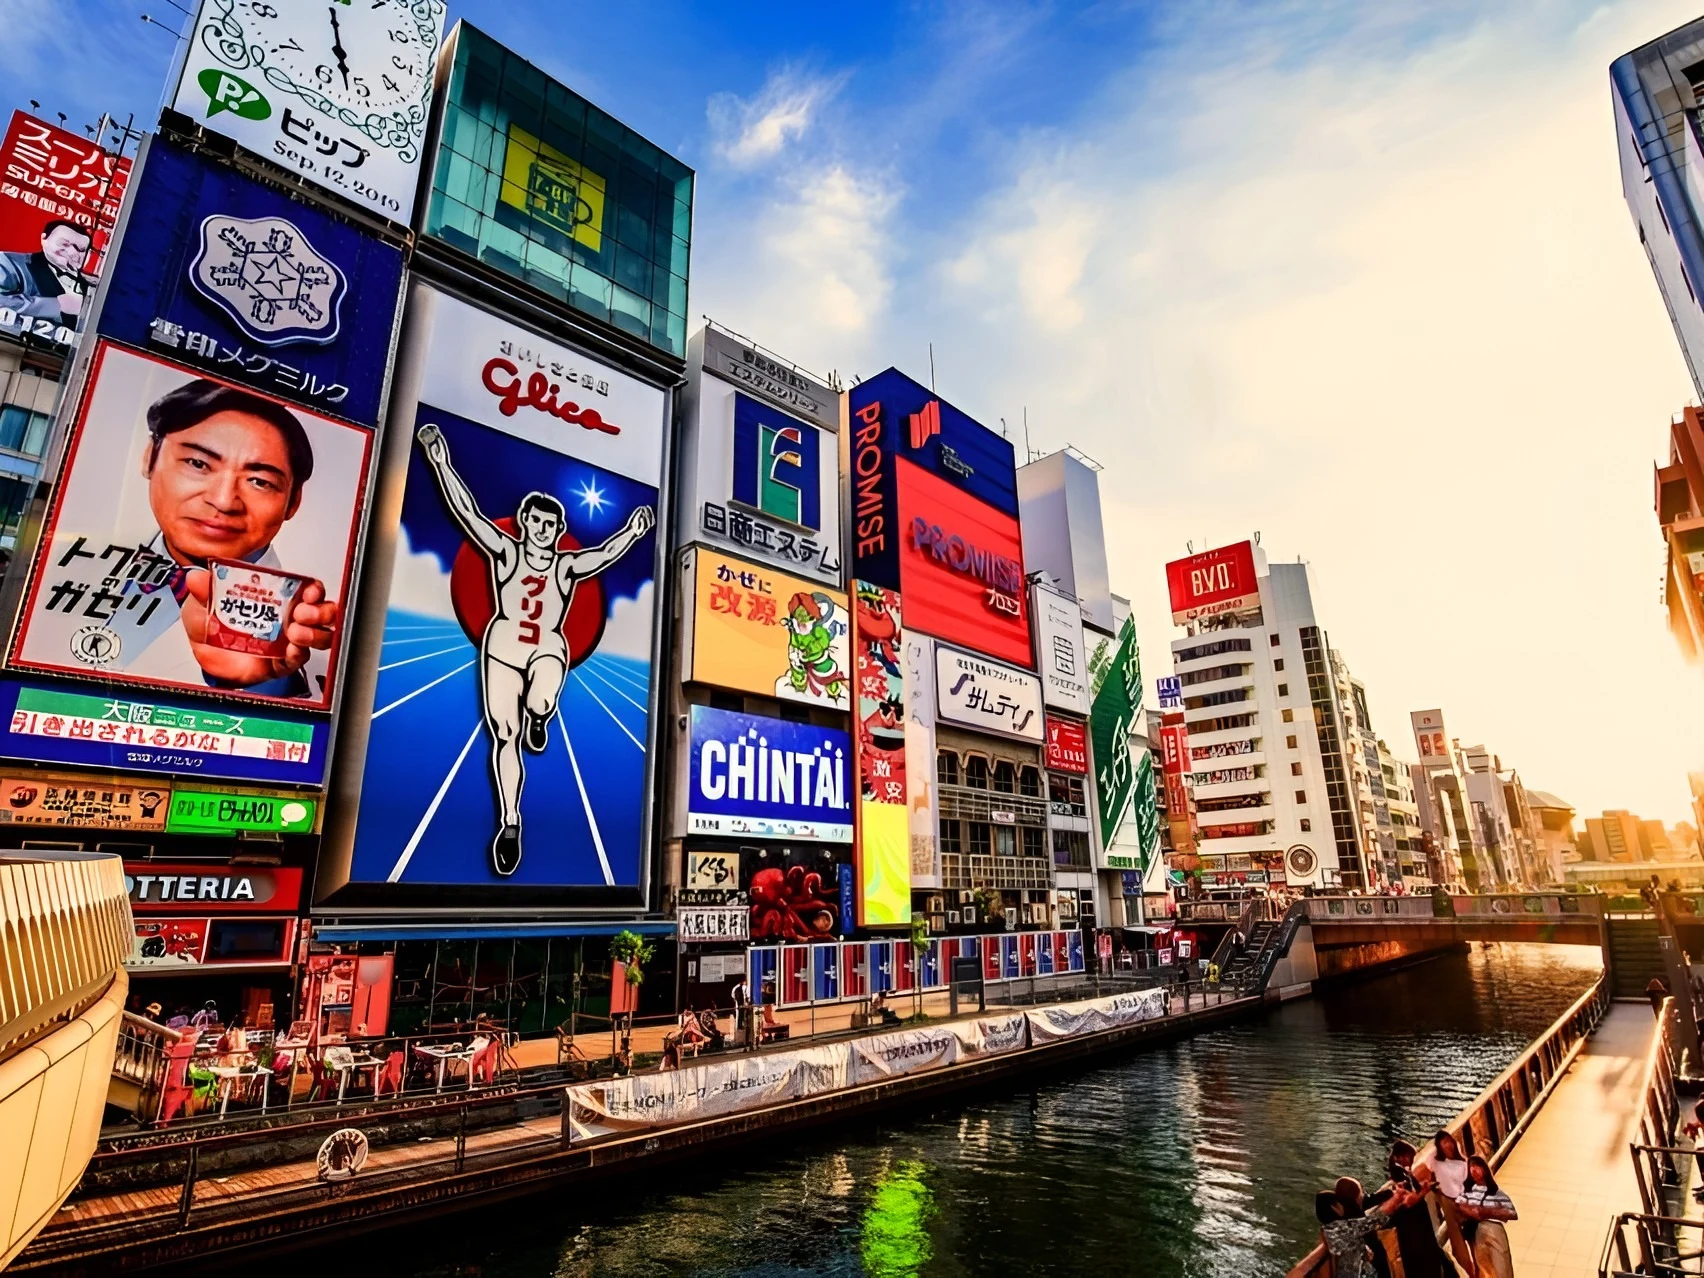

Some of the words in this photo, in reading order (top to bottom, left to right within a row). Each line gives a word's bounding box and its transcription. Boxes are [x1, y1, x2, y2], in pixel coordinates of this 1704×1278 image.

[314, 64, 333, 84] 6
[353, 77, 371, 98] 5
[273, 139, 317, 173] Sep.
[280, 107, 371, 168] ピップ
[5, 163, 87, 206] SUPER
[856, 401, 885, 558] PROMISE
[716, 564, 772, 595] かぜに
[45, 580, 162, 627] ガセリ
[518, 574, 548, 645] グリコ
[709, 582, 777, 626] 改源
